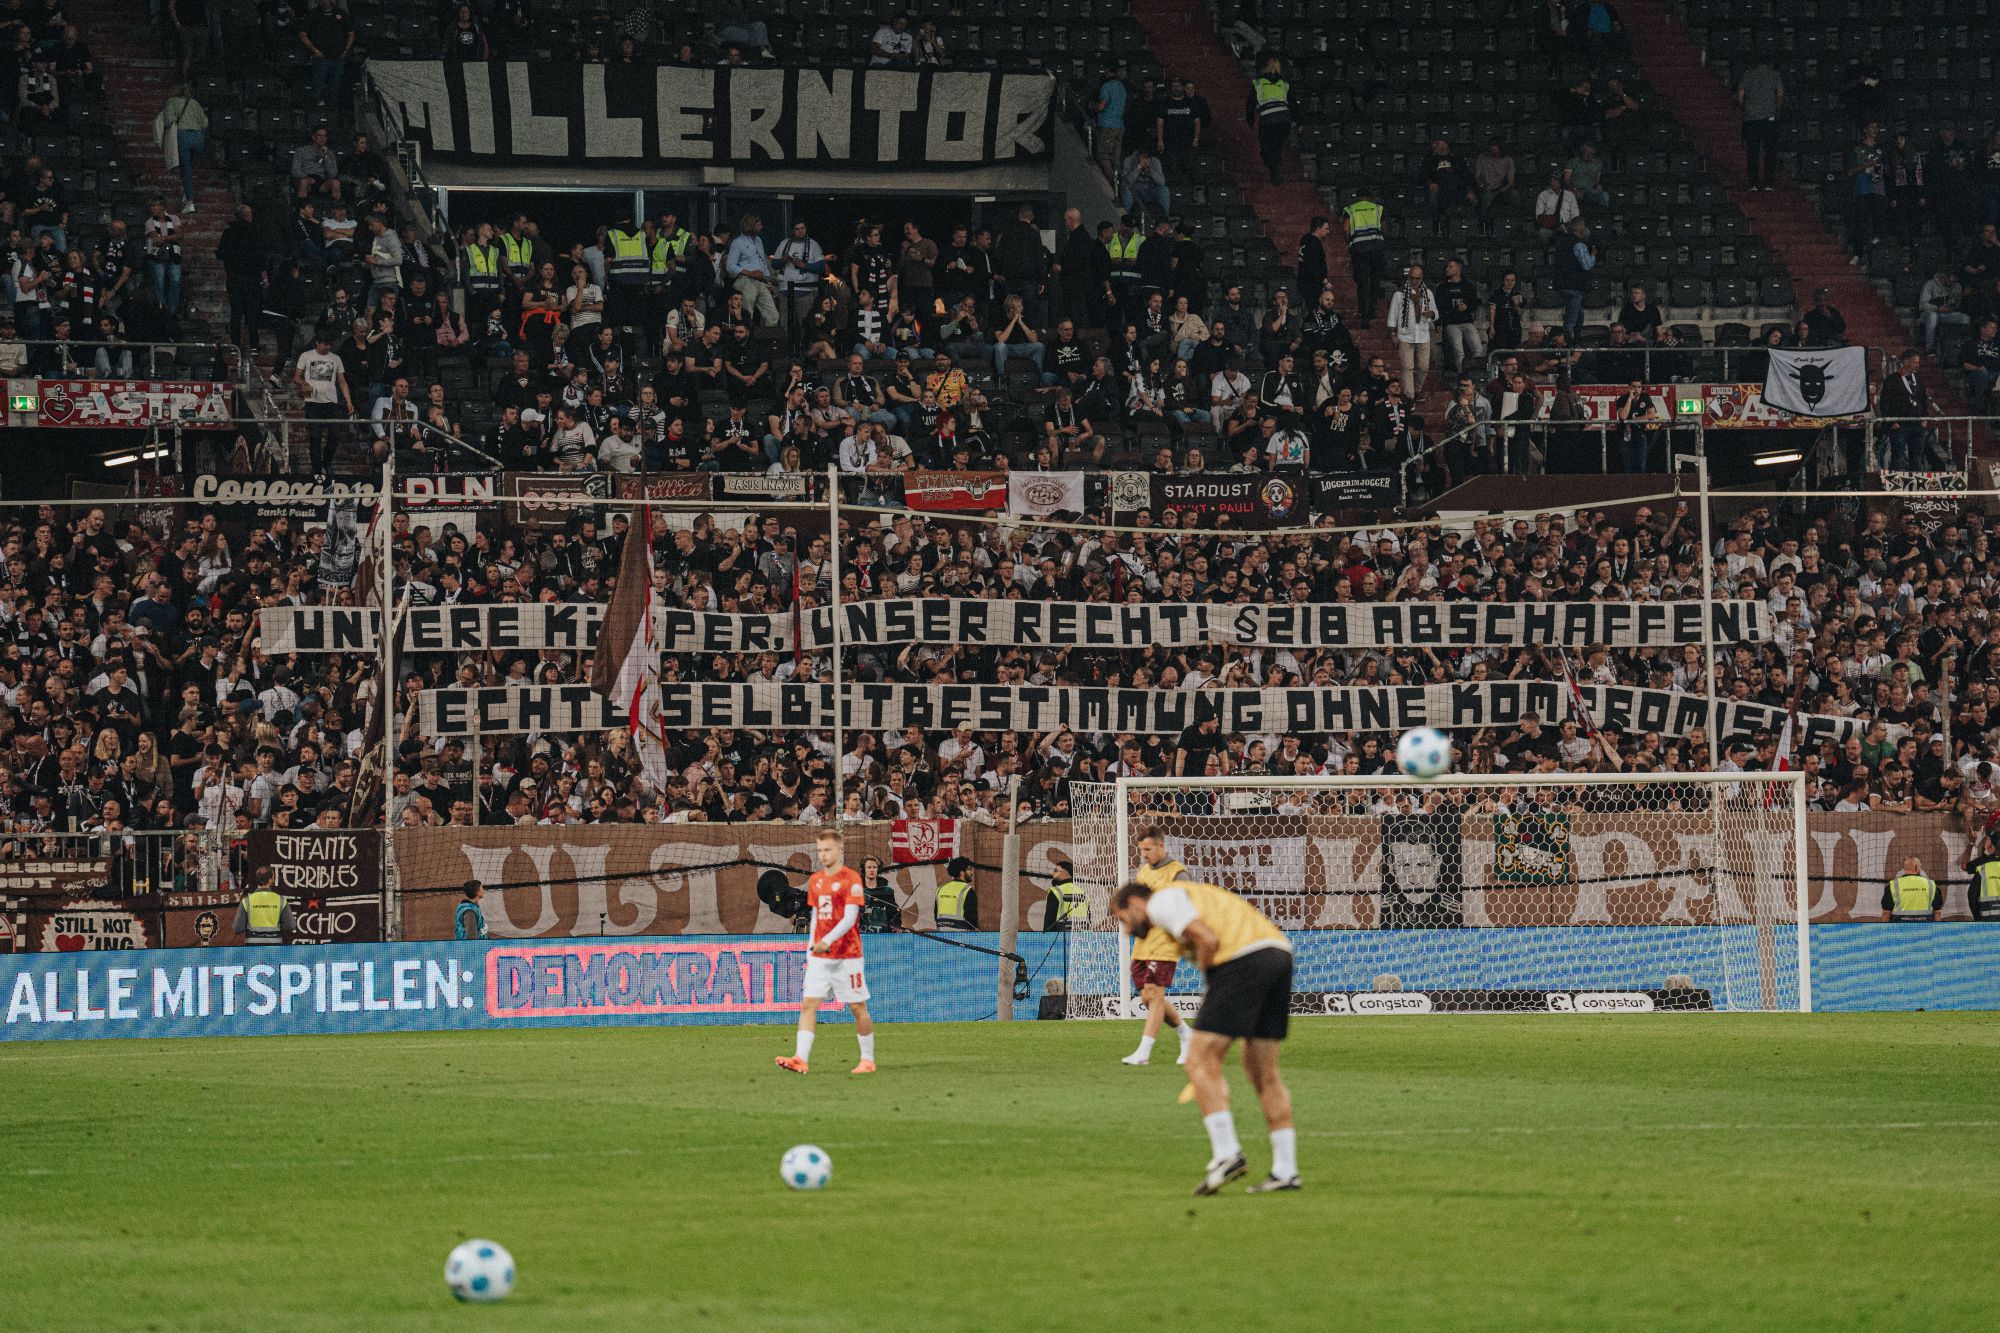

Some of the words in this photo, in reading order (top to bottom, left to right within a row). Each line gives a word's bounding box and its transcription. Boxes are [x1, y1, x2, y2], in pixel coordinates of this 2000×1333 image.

[367, 59, 1055, 161] MILLERNTOR
[80, 391, 231, 420] ASTRA
[1537, 390, 1673, 420] ATA
[404, 476, 494, 505] DLN
[728, 479, 760, 491] CASUS
[761, 479, 801, 491] KNAXUS
[1164, 483, 1252, 498] STARDUST
[257, 507, 287, 517] Sankt
[288, 508, 317, 518] Pauli
[1167, 502, 1207, 513] SAKT
[1219, 501, 1254, 513] PAULI
[545, 605, 785, 652] KPER,
[811, 601, 988, 647] UNSER
[1014, 602, 1209, 645] RECHT!
[1234, 605, 1348, 645] §218
[1373, 602, 1759, 645] ABSCHAFFEN!
[661, 684, 1263, 732] SELBSTBESTIMMUNG
[1287, 687, 1427, 732] OHNE
[275, 835, 358, 860] ENFANTS
[271, 863, 359, 889] TERRIBLES
[54, 917, 98, 934] STILL
[103, 918, 132, 934] NOT
[290, 911, 357, 935] ECCHIO
[5, 969, 139, 1023] ALLE
[152, 958, 476, 1018] MITSPIELEN:
[850, 972, 863, 989] 18
[1359, 997, 1424, 1011] congstar
[1581, 997, 1647, 1011] congstar
